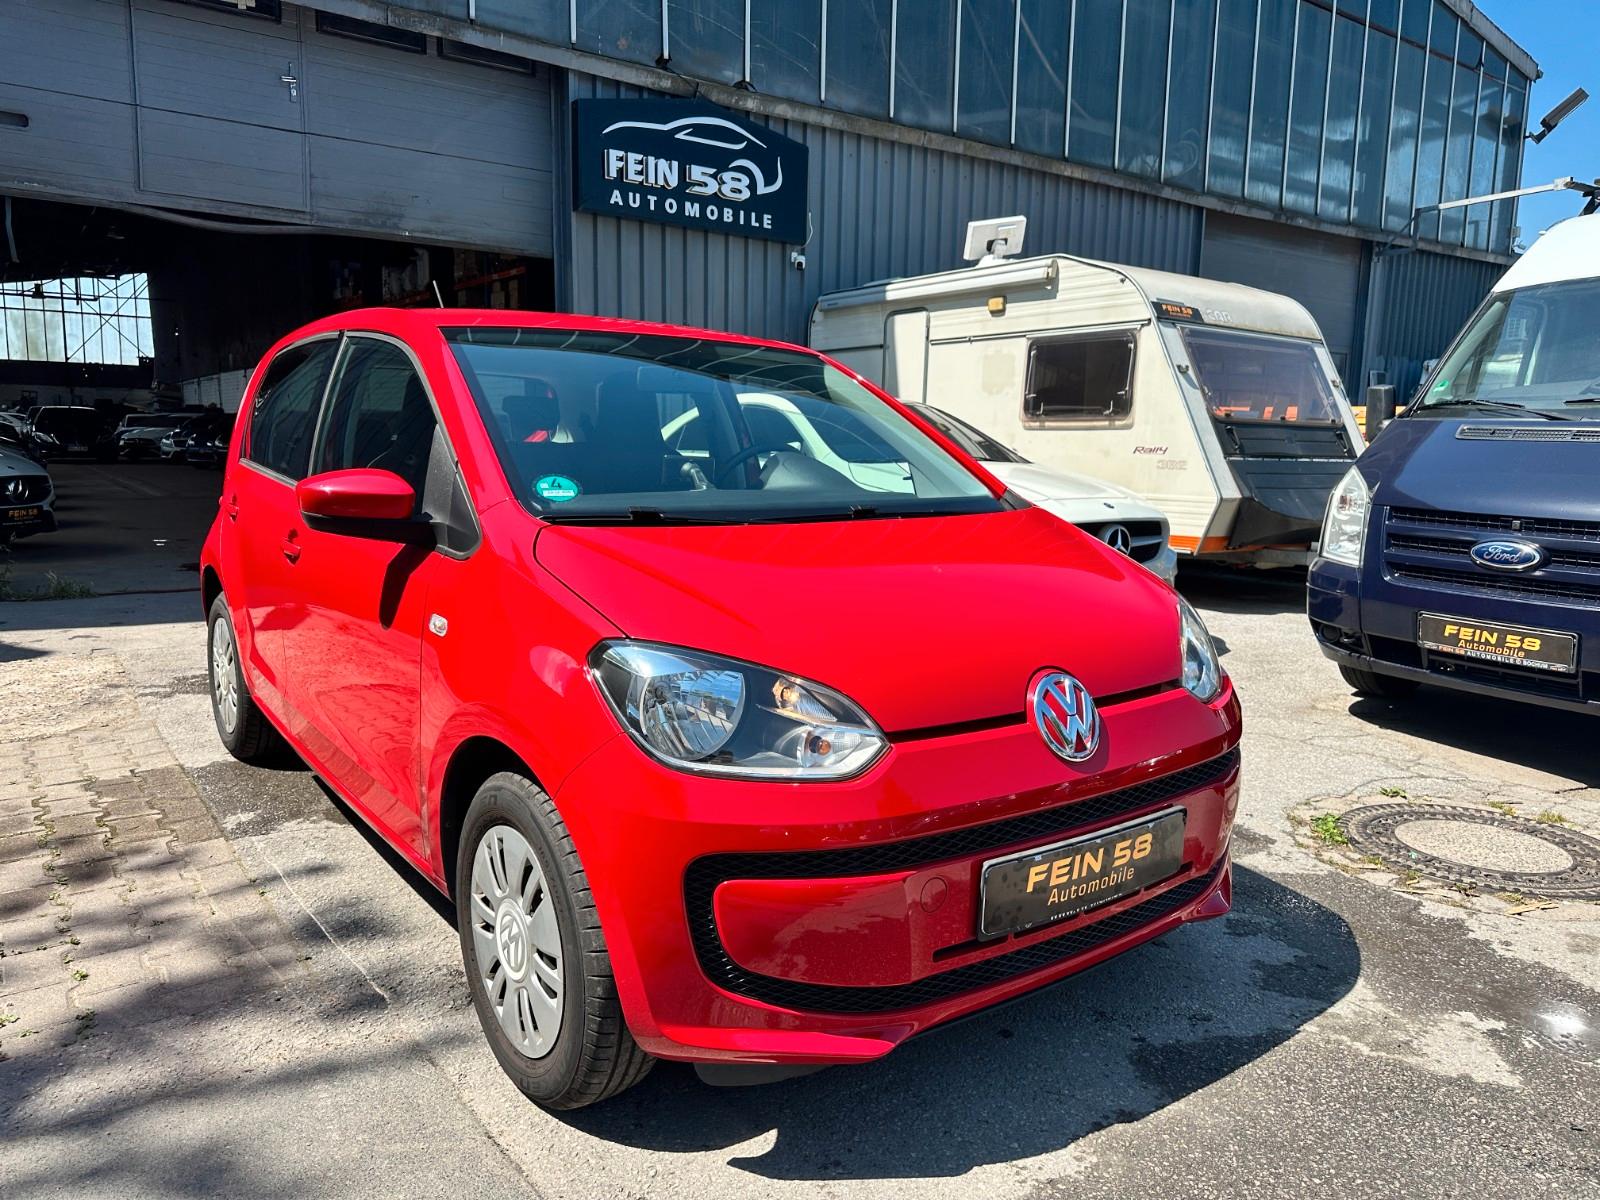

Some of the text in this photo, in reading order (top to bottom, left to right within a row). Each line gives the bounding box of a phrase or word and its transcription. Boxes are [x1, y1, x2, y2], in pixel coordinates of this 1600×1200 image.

[605, 148, 751, 201] FEIN 58
[609, 189, 772, 229] AUTOMOBILE
[1483, 545, 1521, 563] Ford
[1444, 625, 1541, 651] FEIN 58
[1457, 640, 1525, 658] Automobile
[1026, 833, 1153, 893] FEIN 58
[1047, 865, 1135, 906] Automobile
